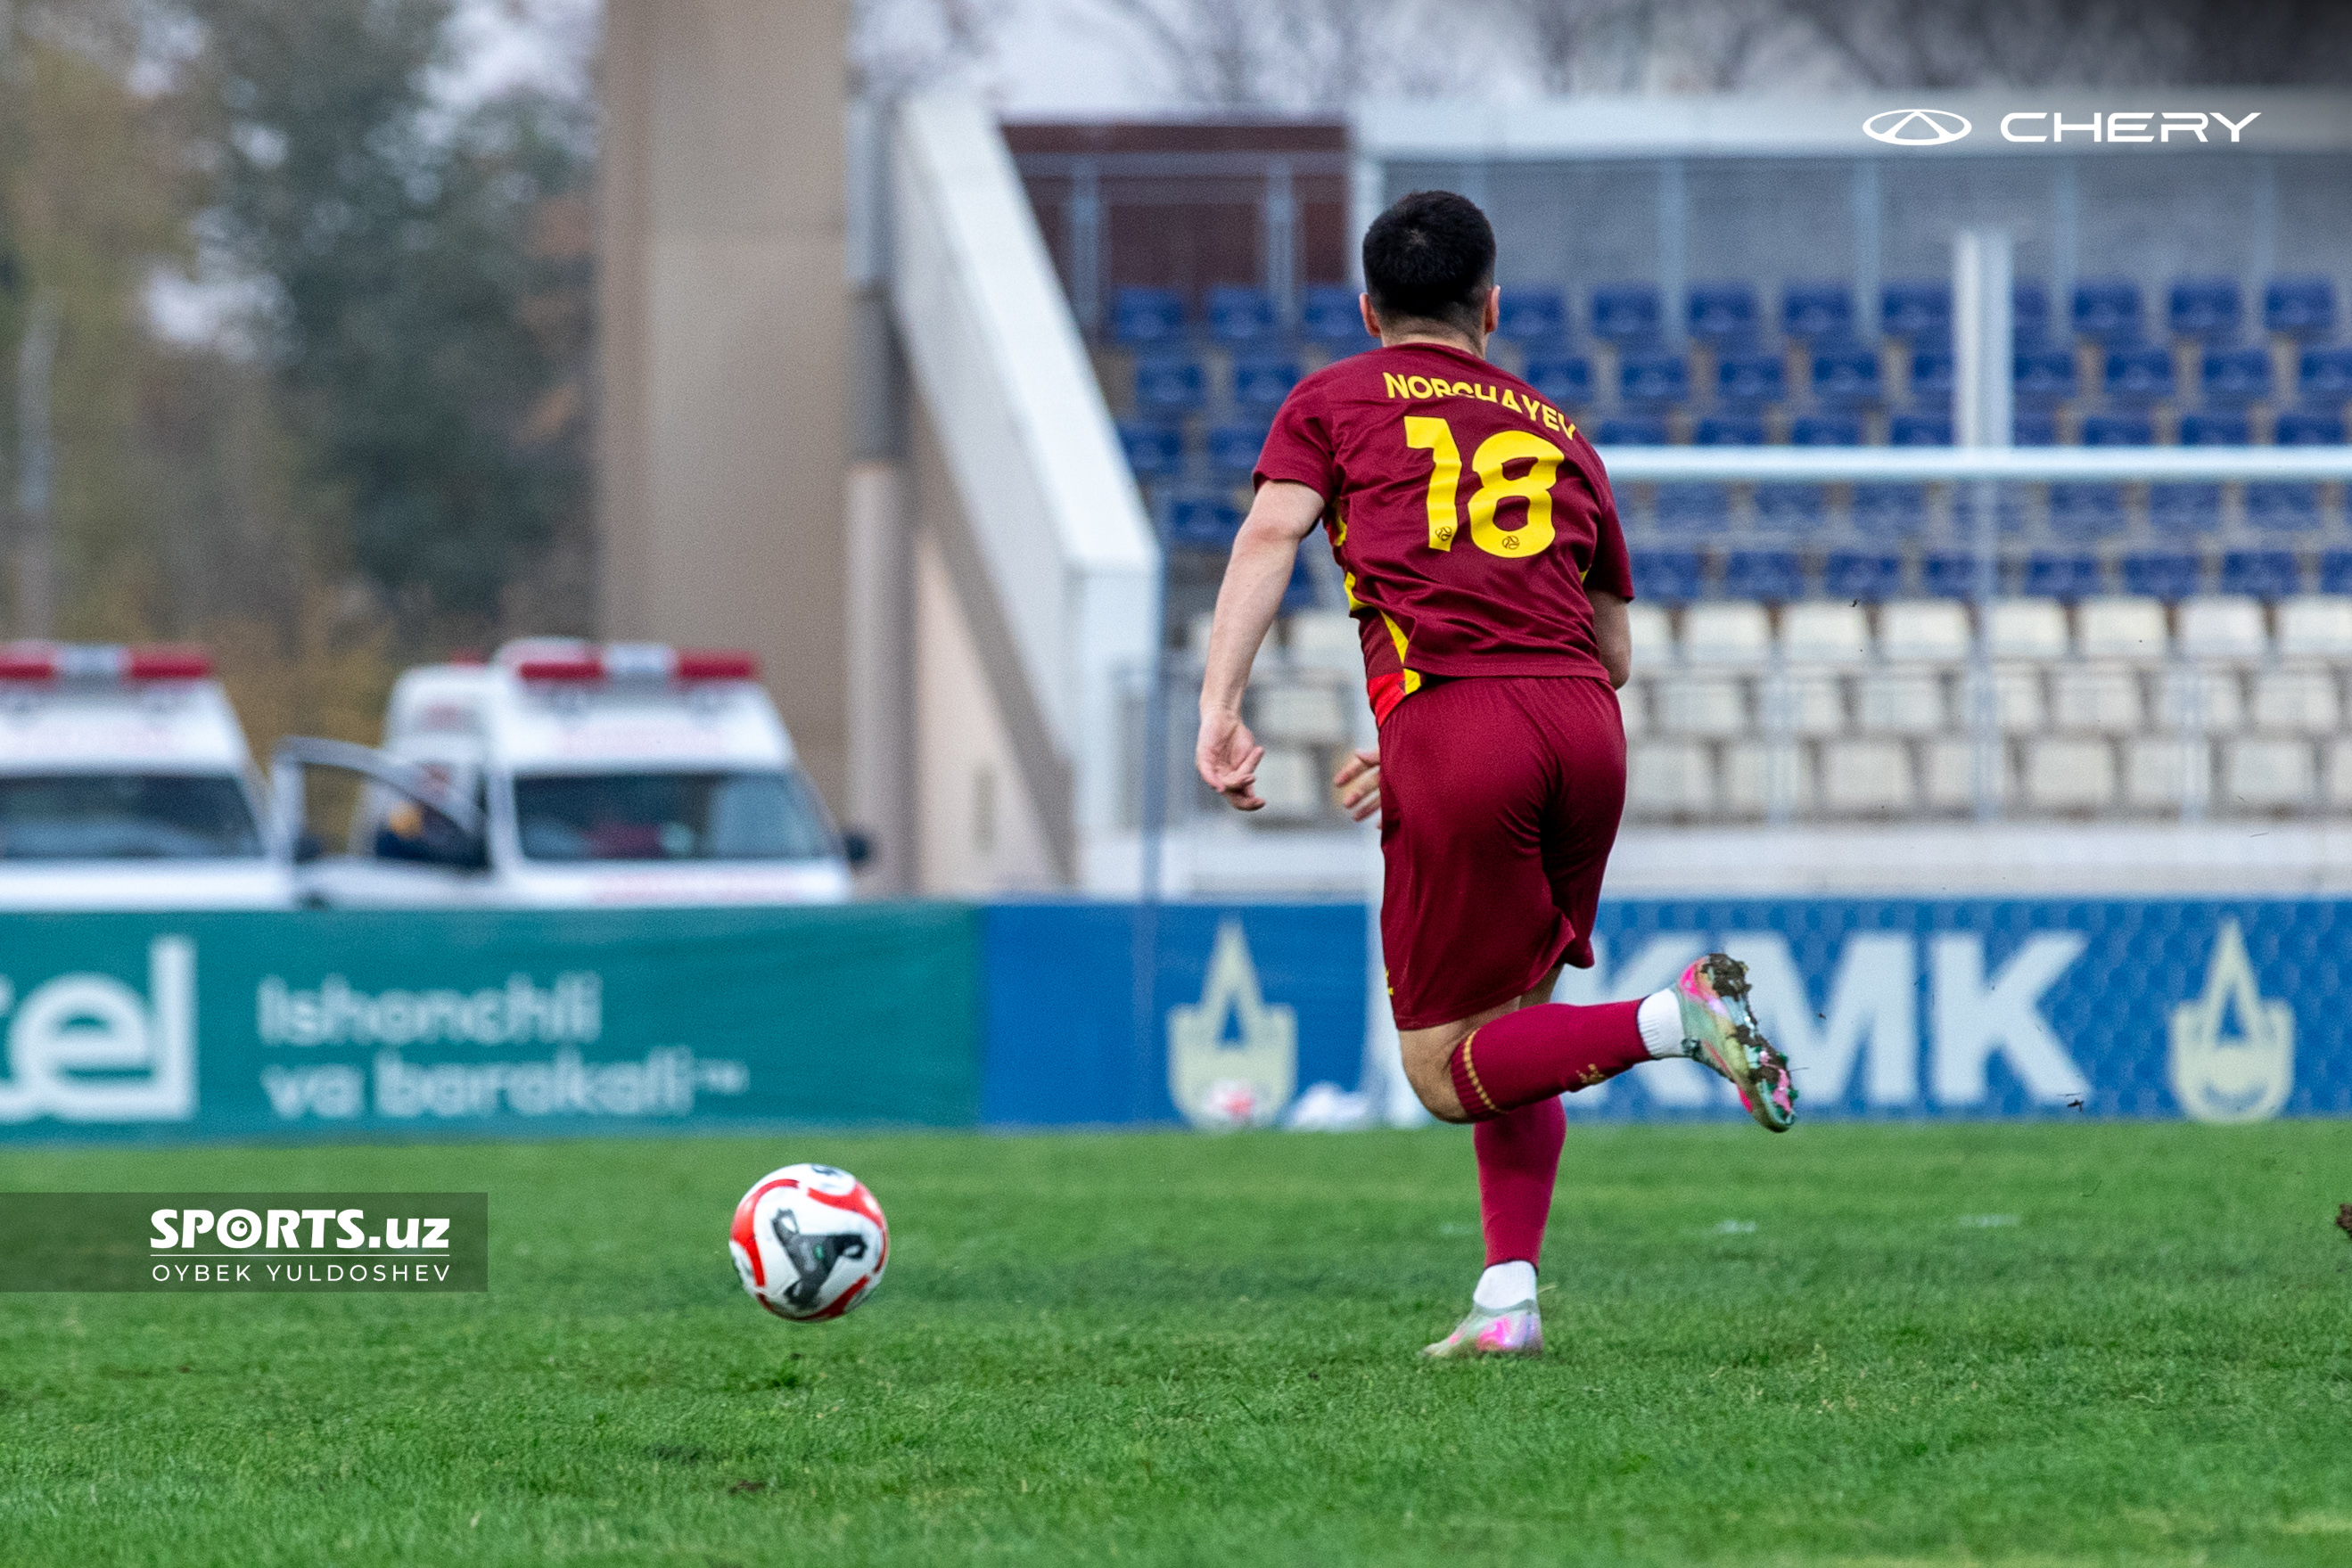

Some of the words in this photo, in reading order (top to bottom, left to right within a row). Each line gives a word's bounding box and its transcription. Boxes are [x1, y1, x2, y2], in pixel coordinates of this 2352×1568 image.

[1403, 415, 1565, 558] 18
[0, 936, 198, 1121] el
[259, 976, 601, 1045] Ishonchli
[262, 1063, 362, 1116] va
